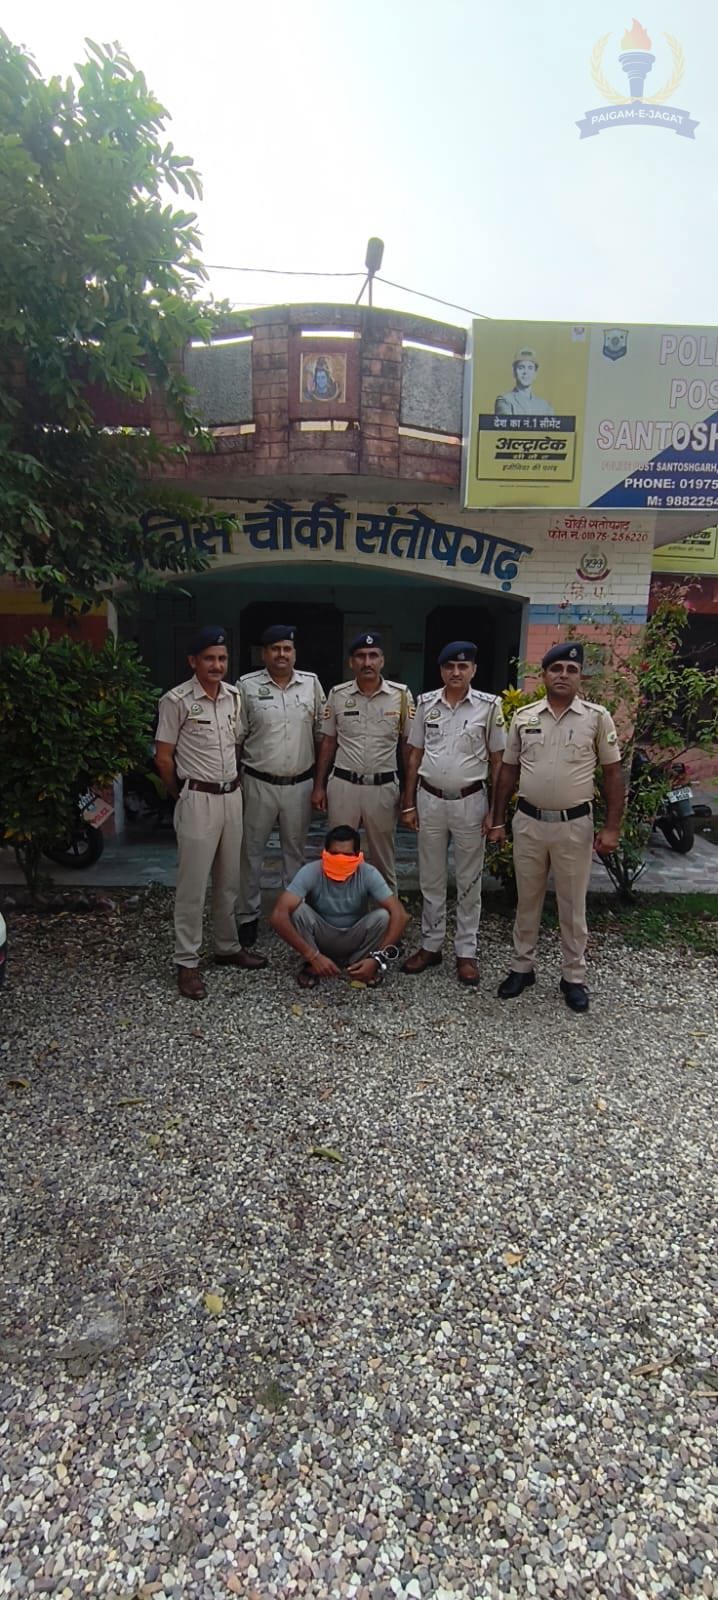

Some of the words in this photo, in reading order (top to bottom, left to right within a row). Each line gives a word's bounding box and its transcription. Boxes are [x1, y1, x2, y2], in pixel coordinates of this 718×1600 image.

[624, 478, 676, 489] PHONE:
[679, 478, 718, 490] 01975
[647, 496, 662, 506] M:
[243, 499, 351, 551] चौकी
[356, 505, 535, 592] संतोषगढ़
